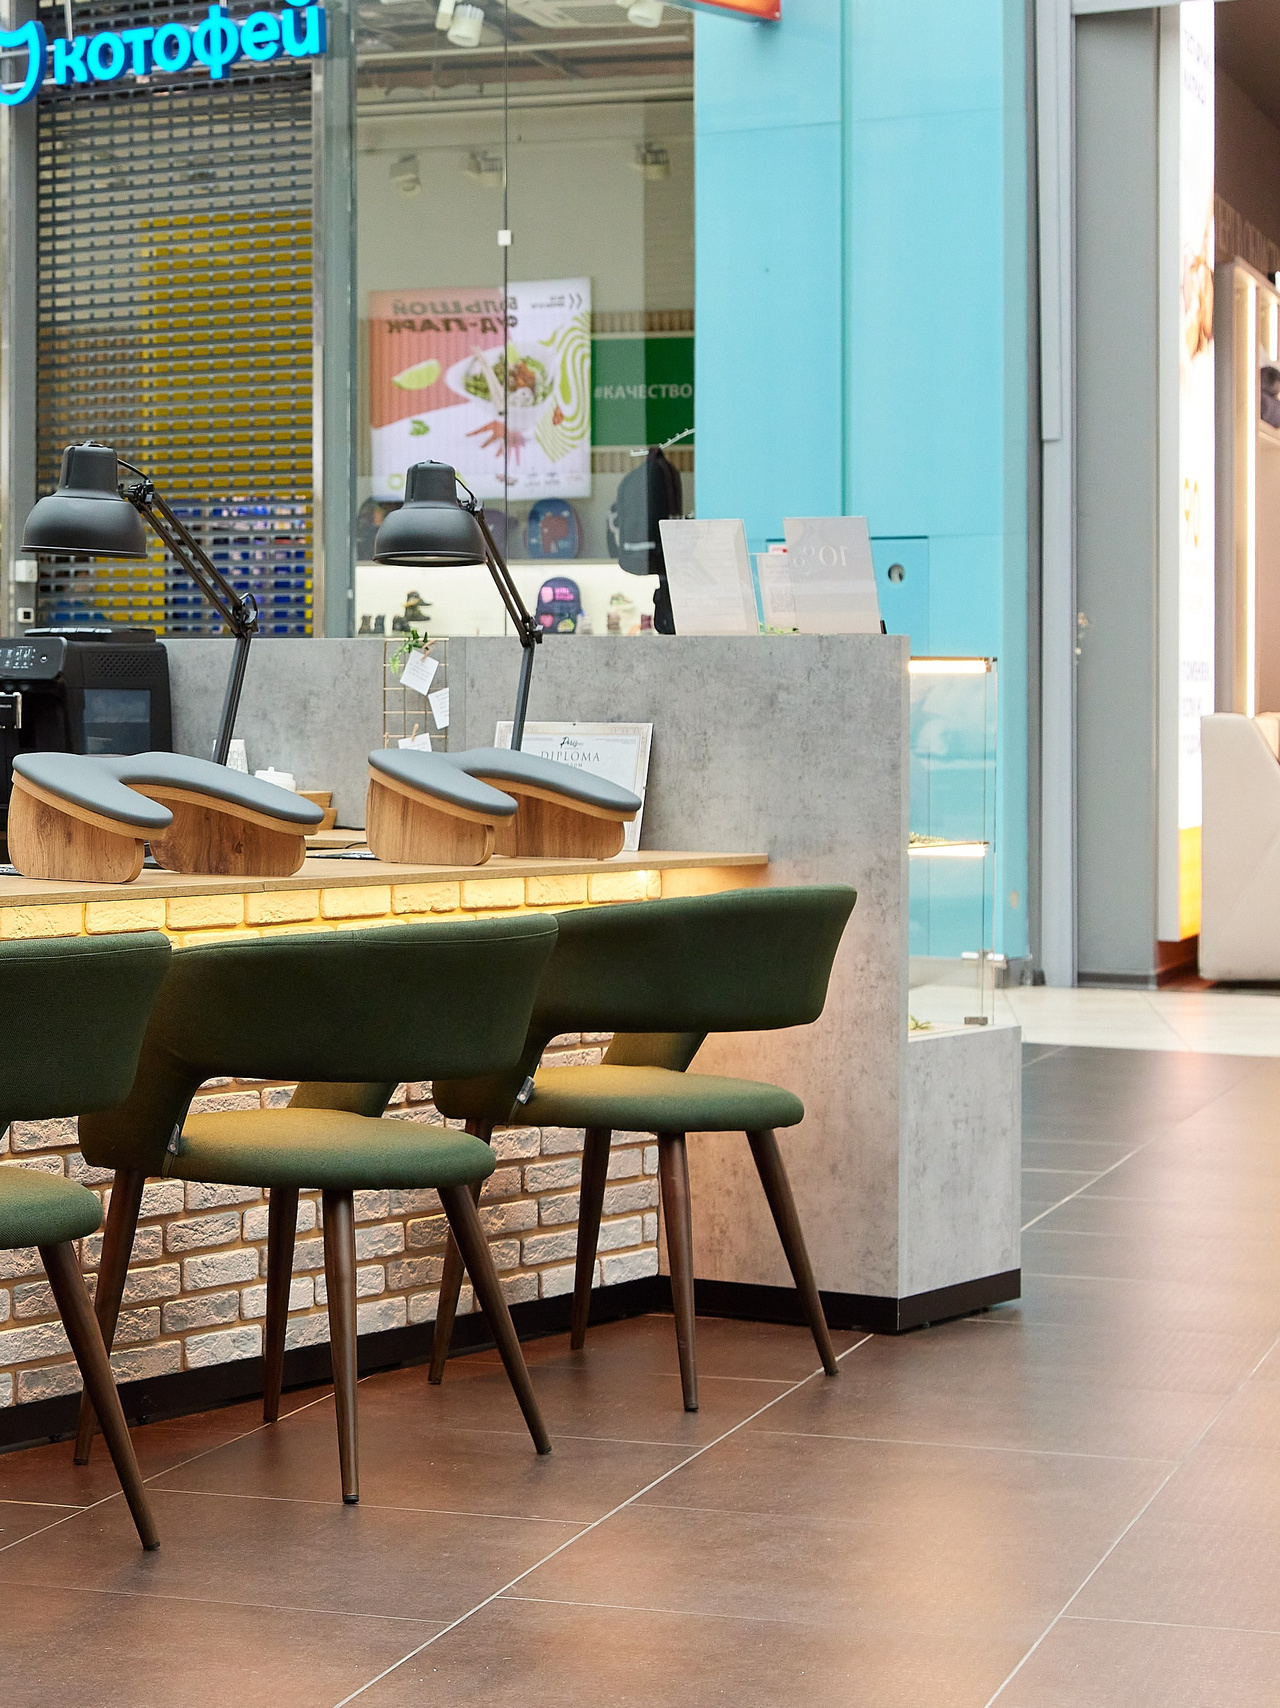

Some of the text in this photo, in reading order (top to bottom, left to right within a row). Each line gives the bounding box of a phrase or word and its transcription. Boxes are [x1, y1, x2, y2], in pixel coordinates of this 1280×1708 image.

[53, 0, 325, 85] котофей
[594, 383, 693, 400] #КАЧЕСТВО
[540, 750, 601, 762] DIPLOMA
